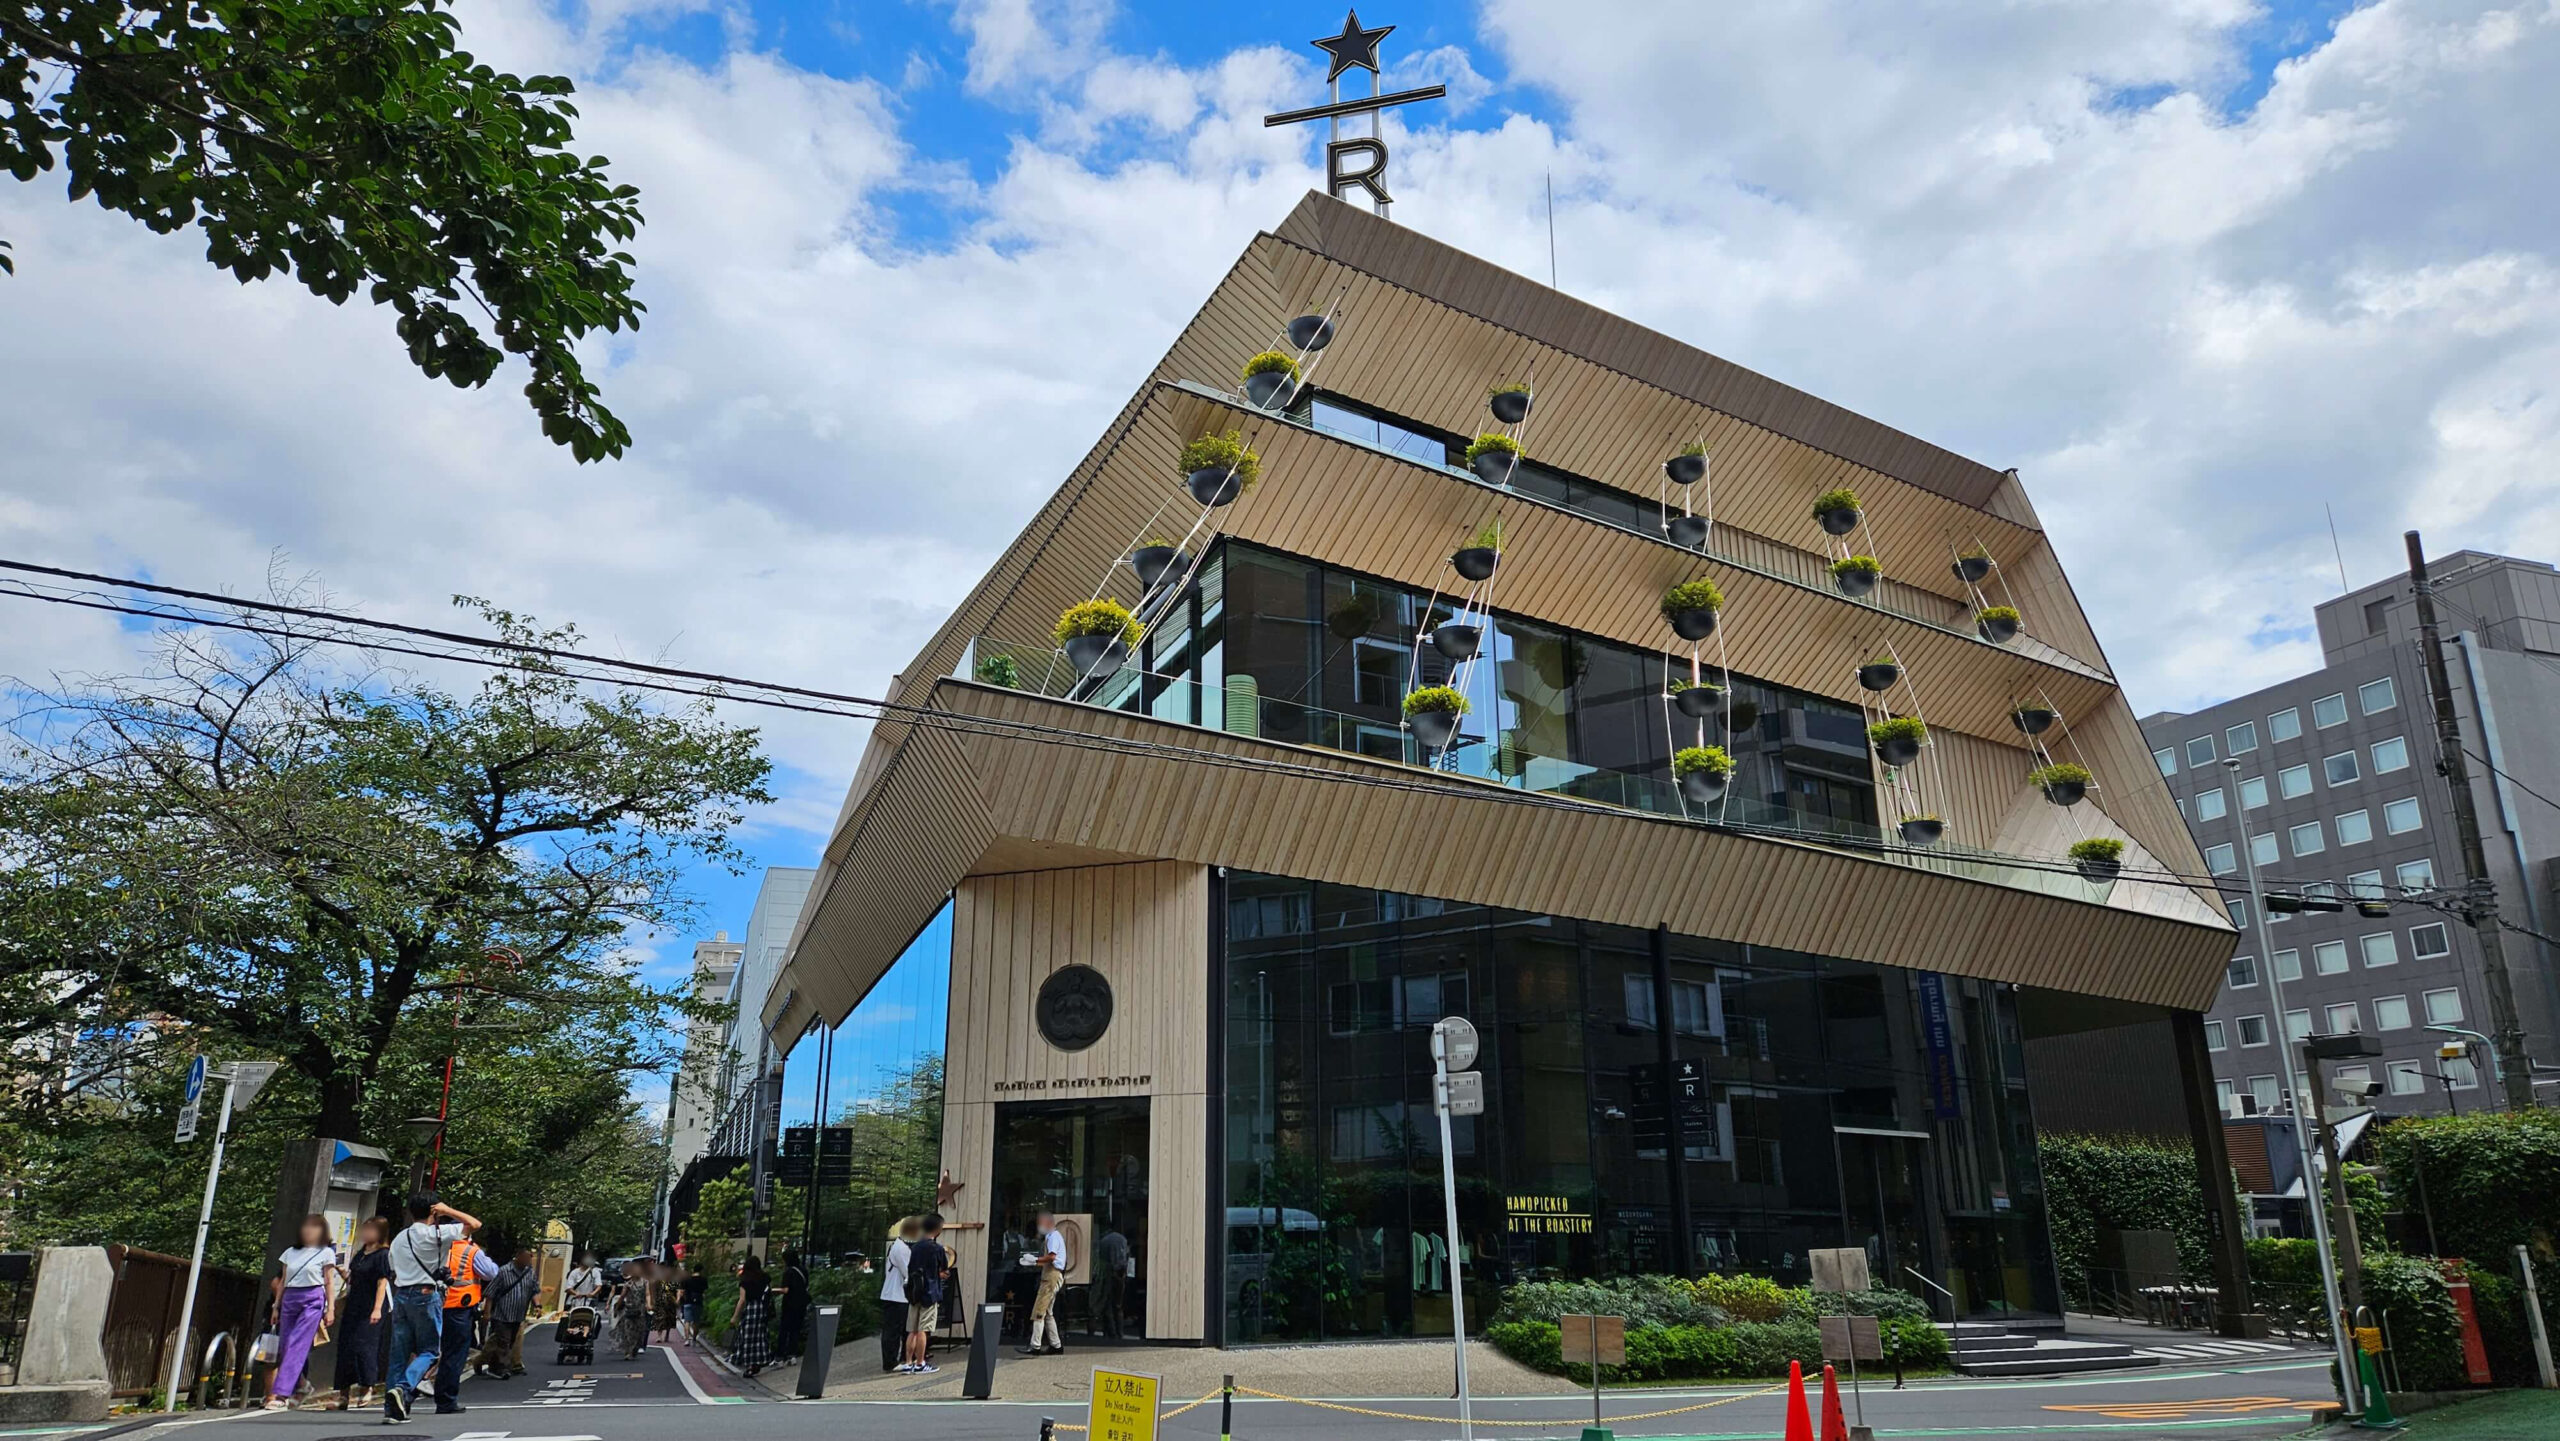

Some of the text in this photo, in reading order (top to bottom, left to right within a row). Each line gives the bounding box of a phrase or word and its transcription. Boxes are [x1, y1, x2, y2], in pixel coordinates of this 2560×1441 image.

[1327, 138, 1394, 203] R
[994, 1075, 1151, 1092] STARBUCKS RESERVE ROASTERY
[1685, 1084, 1695, 1096] R
[1506, 1196, 1568, 1213] HANDPICKED
[1508, 1218, 1592, 1234] AT THE ROASTERY
[1104, 1377, 1144, 1398] 立入禁止
[1105, 1399, 1141, 1413] Do Not Enter
